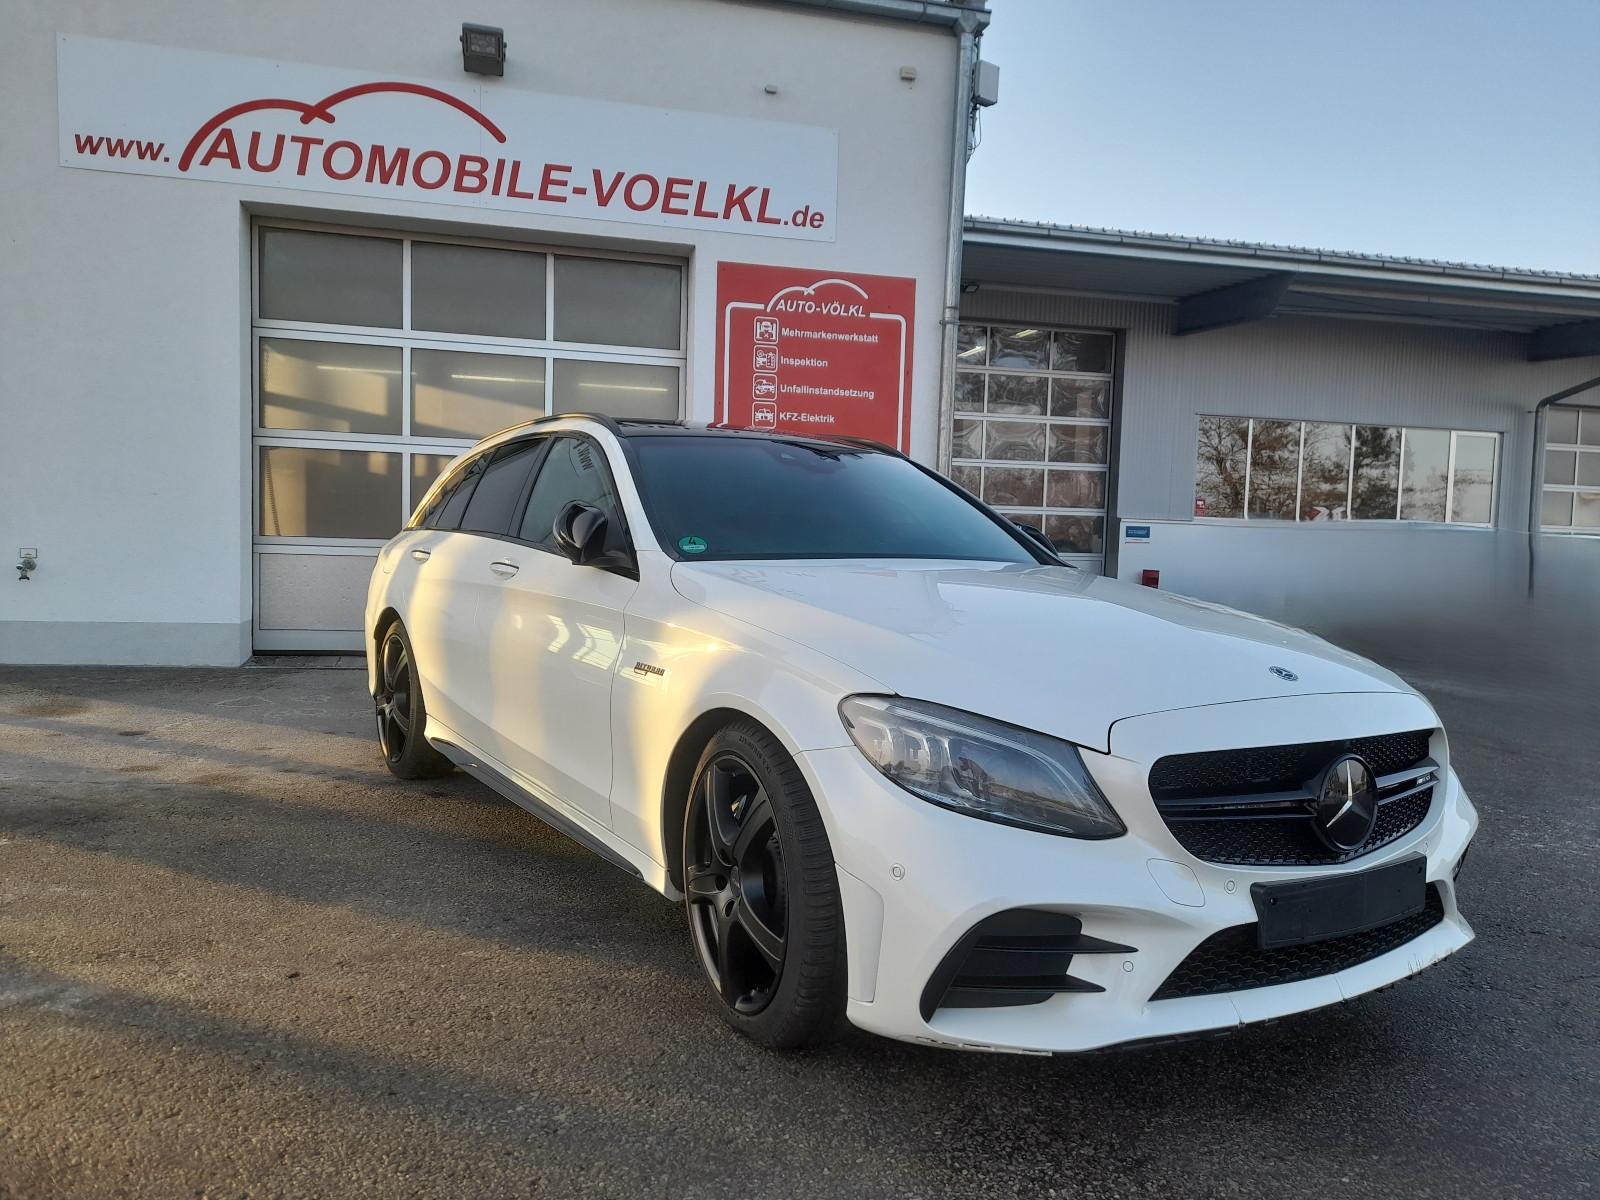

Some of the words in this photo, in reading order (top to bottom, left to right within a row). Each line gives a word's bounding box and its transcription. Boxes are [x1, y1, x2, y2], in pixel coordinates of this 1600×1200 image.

[776, 300, 866, 317] AUTO-VÖLKL
[781, 328, 879, 343] Mehrmarkenwerkstatt
[780, 356, 829, 368] Inspektion
[780, 384, 875, 400] Unfallinstandsetzung
[779, 411, 835, 424] KFZ-Elektrik
